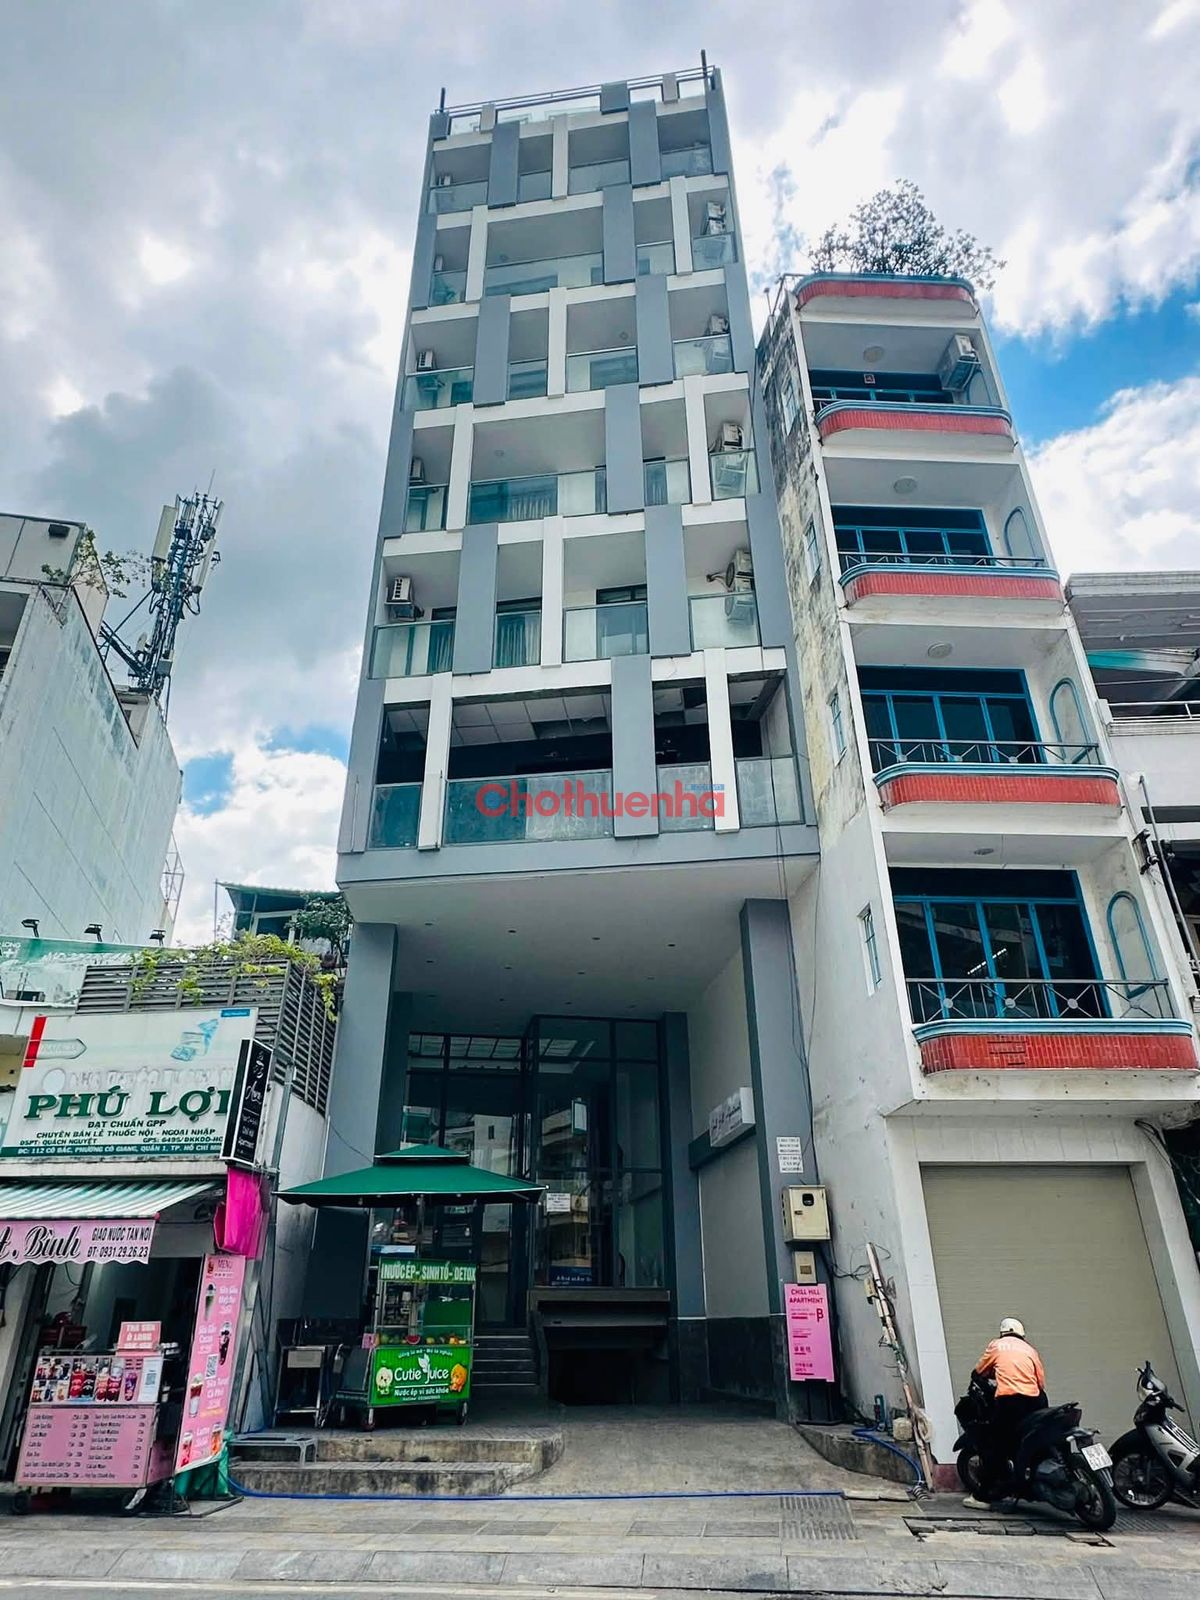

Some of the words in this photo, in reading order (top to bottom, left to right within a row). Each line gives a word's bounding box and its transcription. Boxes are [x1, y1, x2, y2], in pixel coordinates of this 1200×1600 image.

[23, 1085, 130, 1120] PHÚ
[88, 1121, 107, 1129] ĐẠT
[36, 1129, 71, 1138] CHUYÊN
[92, 1227, 107, 1241] GIAO
[24, 1224, 82, 1260] Bình
[87, 1247, 98, 1257] ĐT:
[99, 1246, 149, 1258] 0931.29.26.23
[790, 1288, 807, 1296] CHILL
[394, 1367, 421, 1381] Cutie
[424, 1364, 449, 1385] Juice
